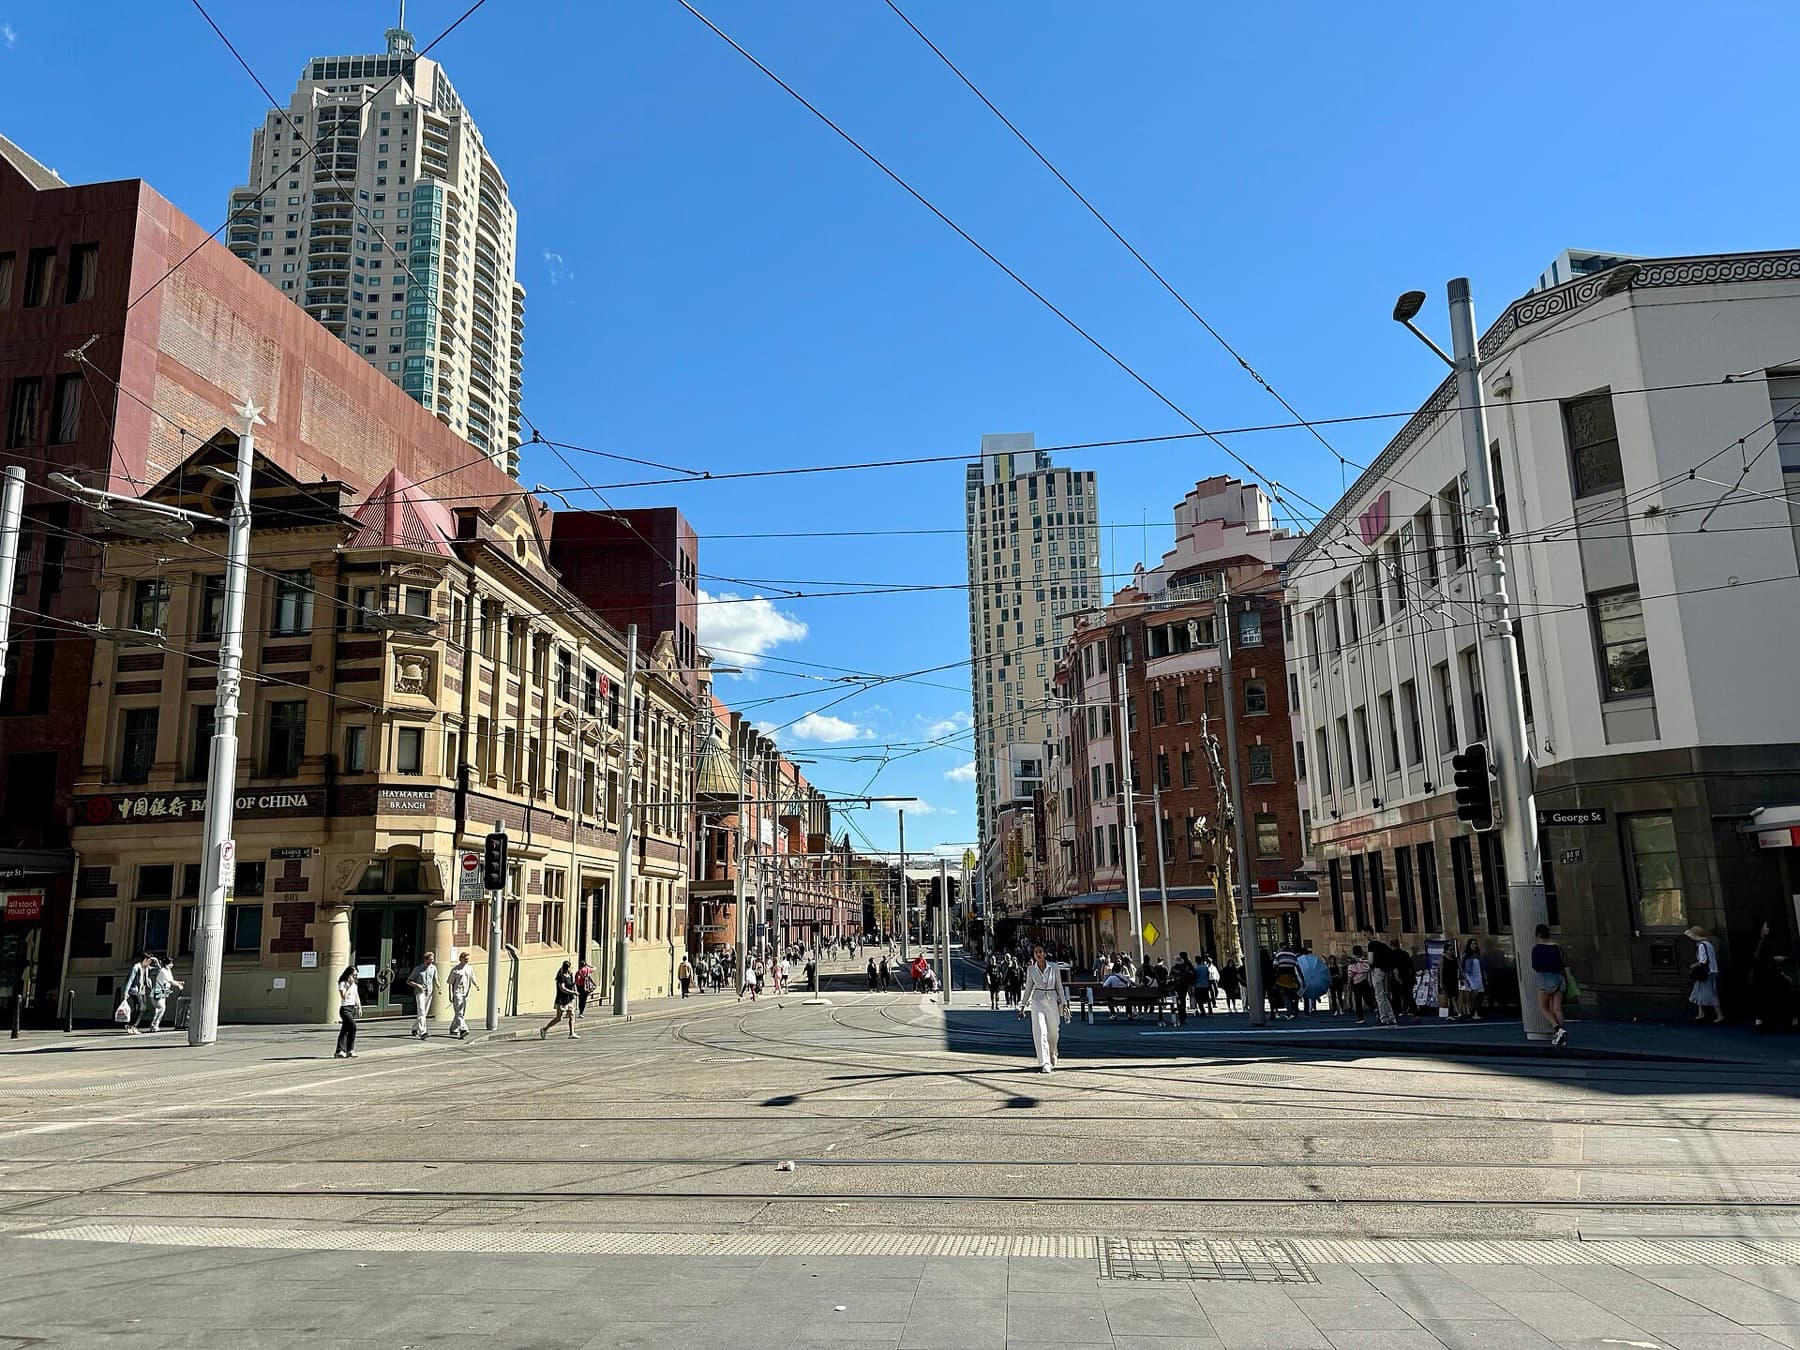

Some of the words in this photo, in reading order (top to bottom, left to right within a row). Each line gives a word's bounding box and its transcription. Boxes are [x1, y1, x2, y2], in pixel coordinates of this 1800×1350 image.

[382, 790, 434, 799] HAYMARKET
[235, 797, 256, 809] OF
[258, 794, 308, 808] CHINA
[390, 801, 426, 809] BRANCH
[1552, 813, 1589, 824] George
[1591, 812, 1602, 821] St
[19, 900, 37, 908] stock
[26, 907, 39, 916] go!
